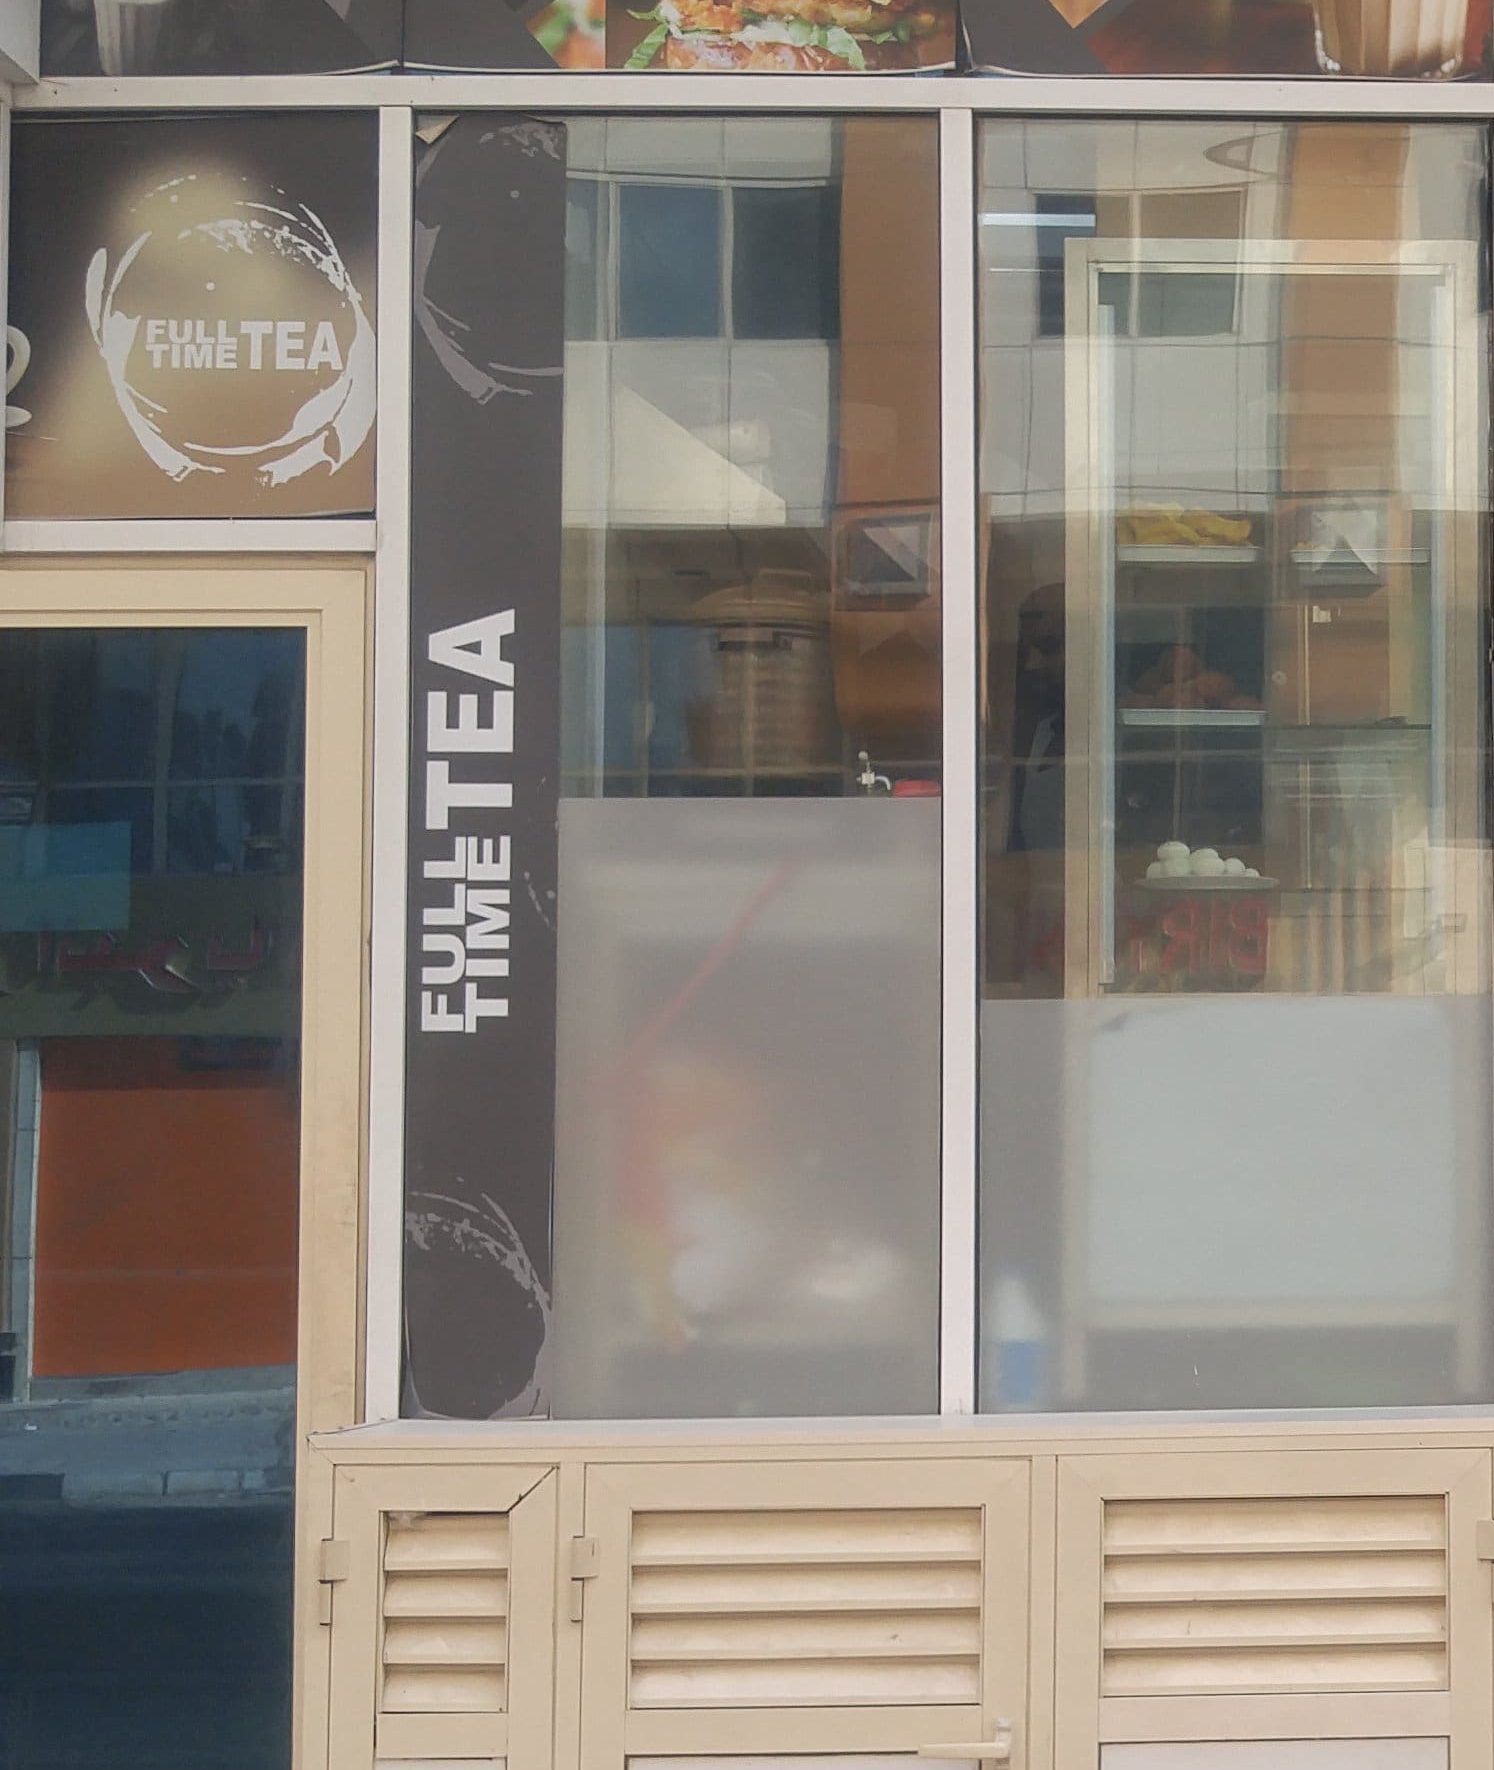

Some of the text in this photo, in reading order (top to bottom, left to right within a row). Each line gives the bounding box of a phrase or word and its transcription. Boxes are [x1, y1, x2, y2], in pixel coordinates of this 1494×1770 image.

[146, 319, 238, 346] FULL
[146, 342, 238, 369] TIME
[240, 320, 344, 371] TEA
[425, 608, 515, 830] TEA
[421, 835, 467, 1033] FULL
[464, 834, 511, 1034] TIME
